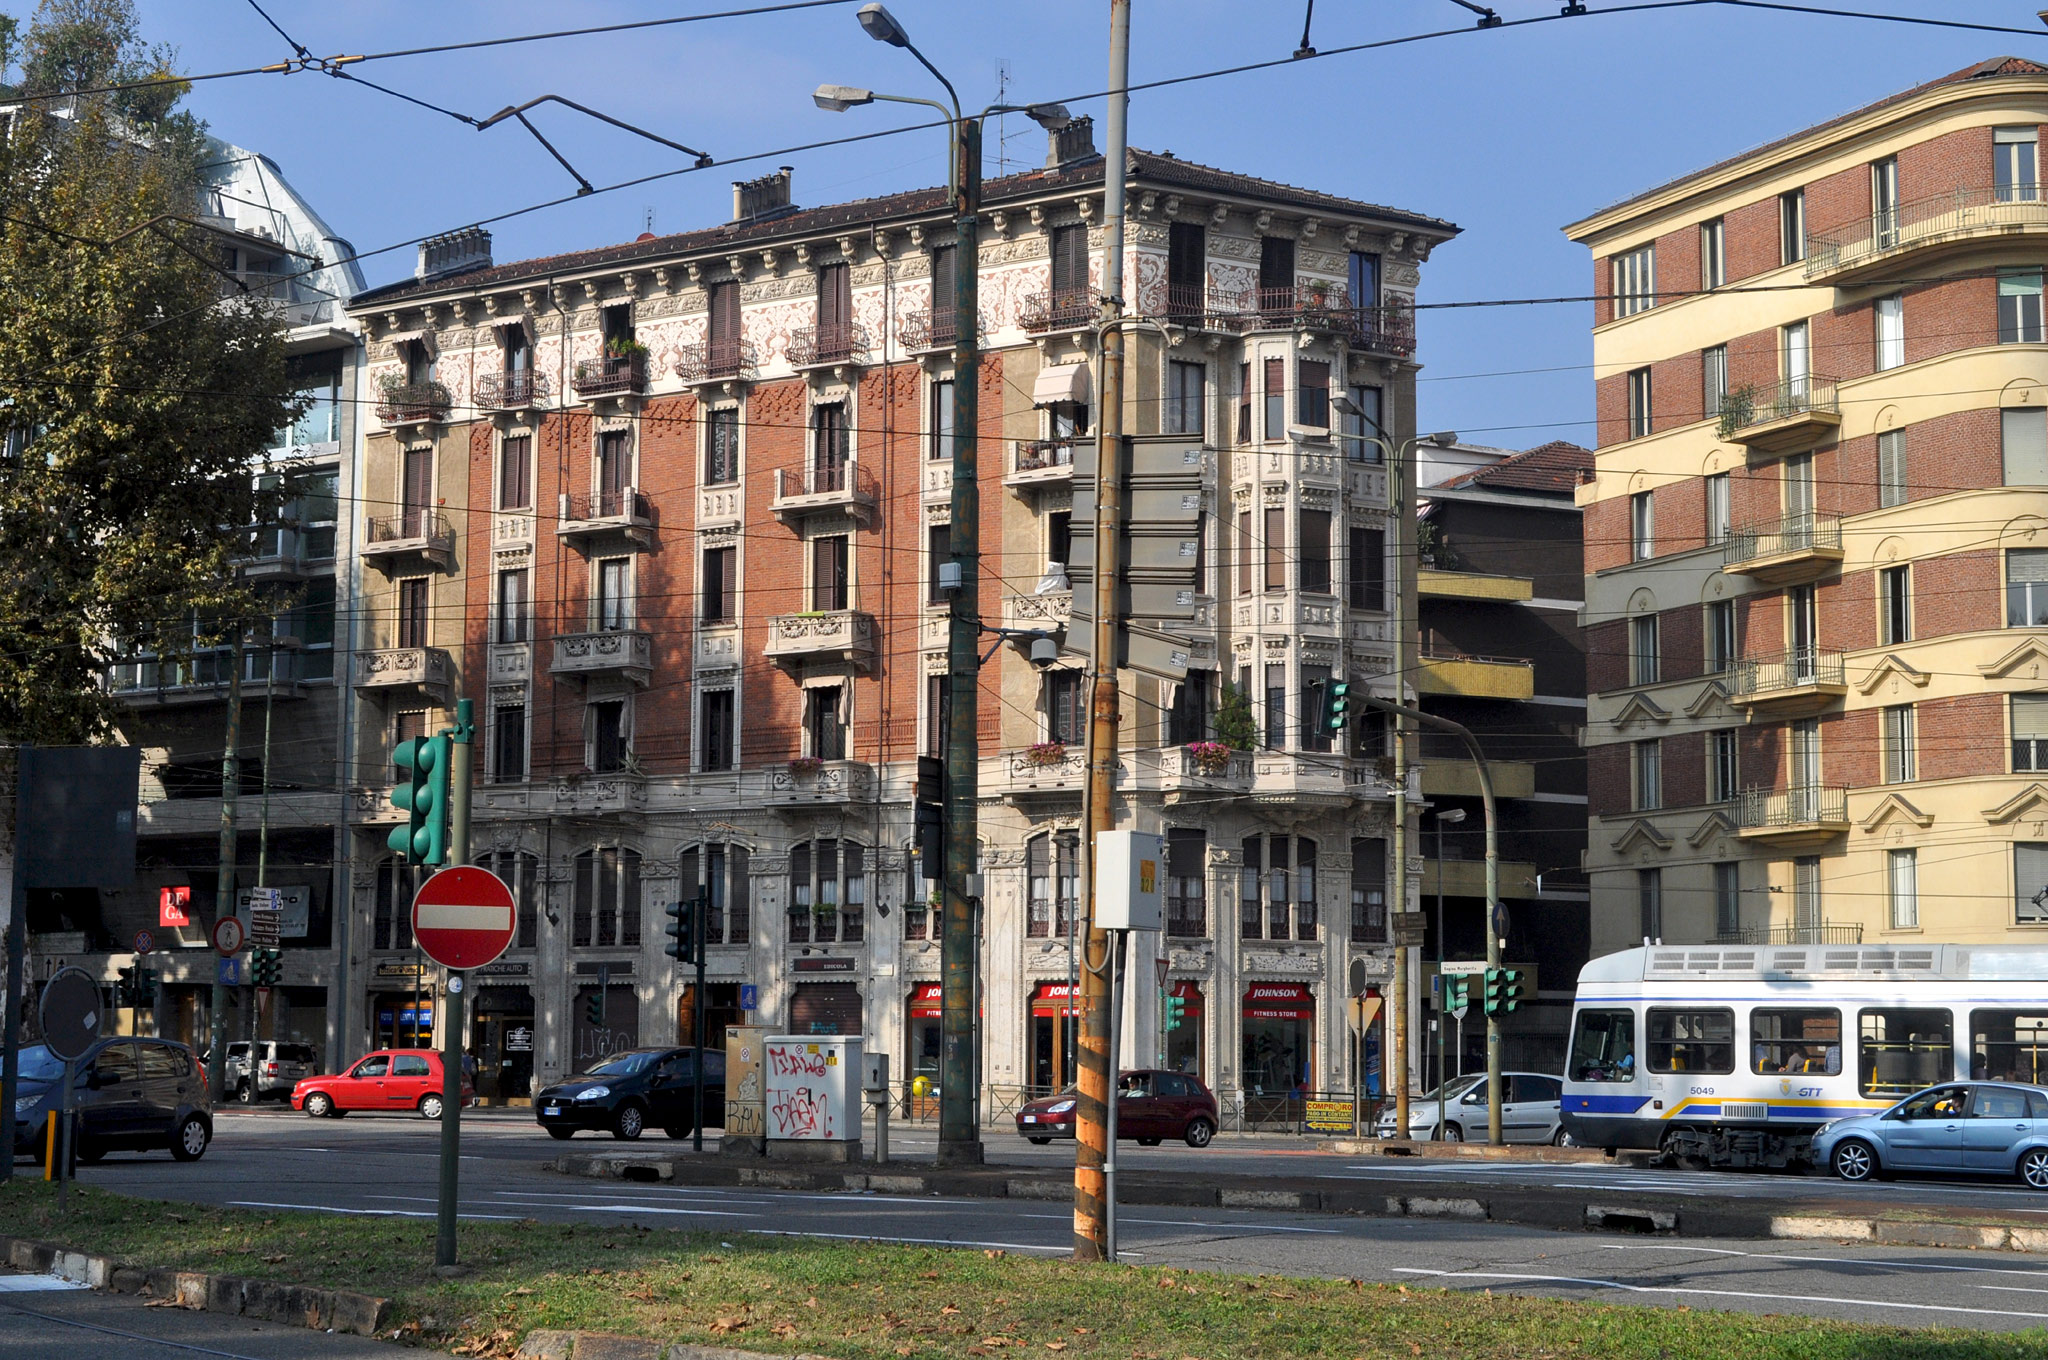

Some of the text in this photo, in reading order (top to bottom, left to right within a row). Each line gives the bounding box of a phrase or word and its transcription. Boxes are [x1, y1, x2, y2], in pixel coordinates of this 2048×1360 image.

[165, 892, 185, 906] DE
[165, 906, 184, 920] GA
[481, 964, 523, 973] PRATICHE AUTO
[1253, 988, 1299, 998] JOHNSON
[1690, 1086, 1715, 1096] 5049
[1797, 1087, 1823, 1097] GTT
